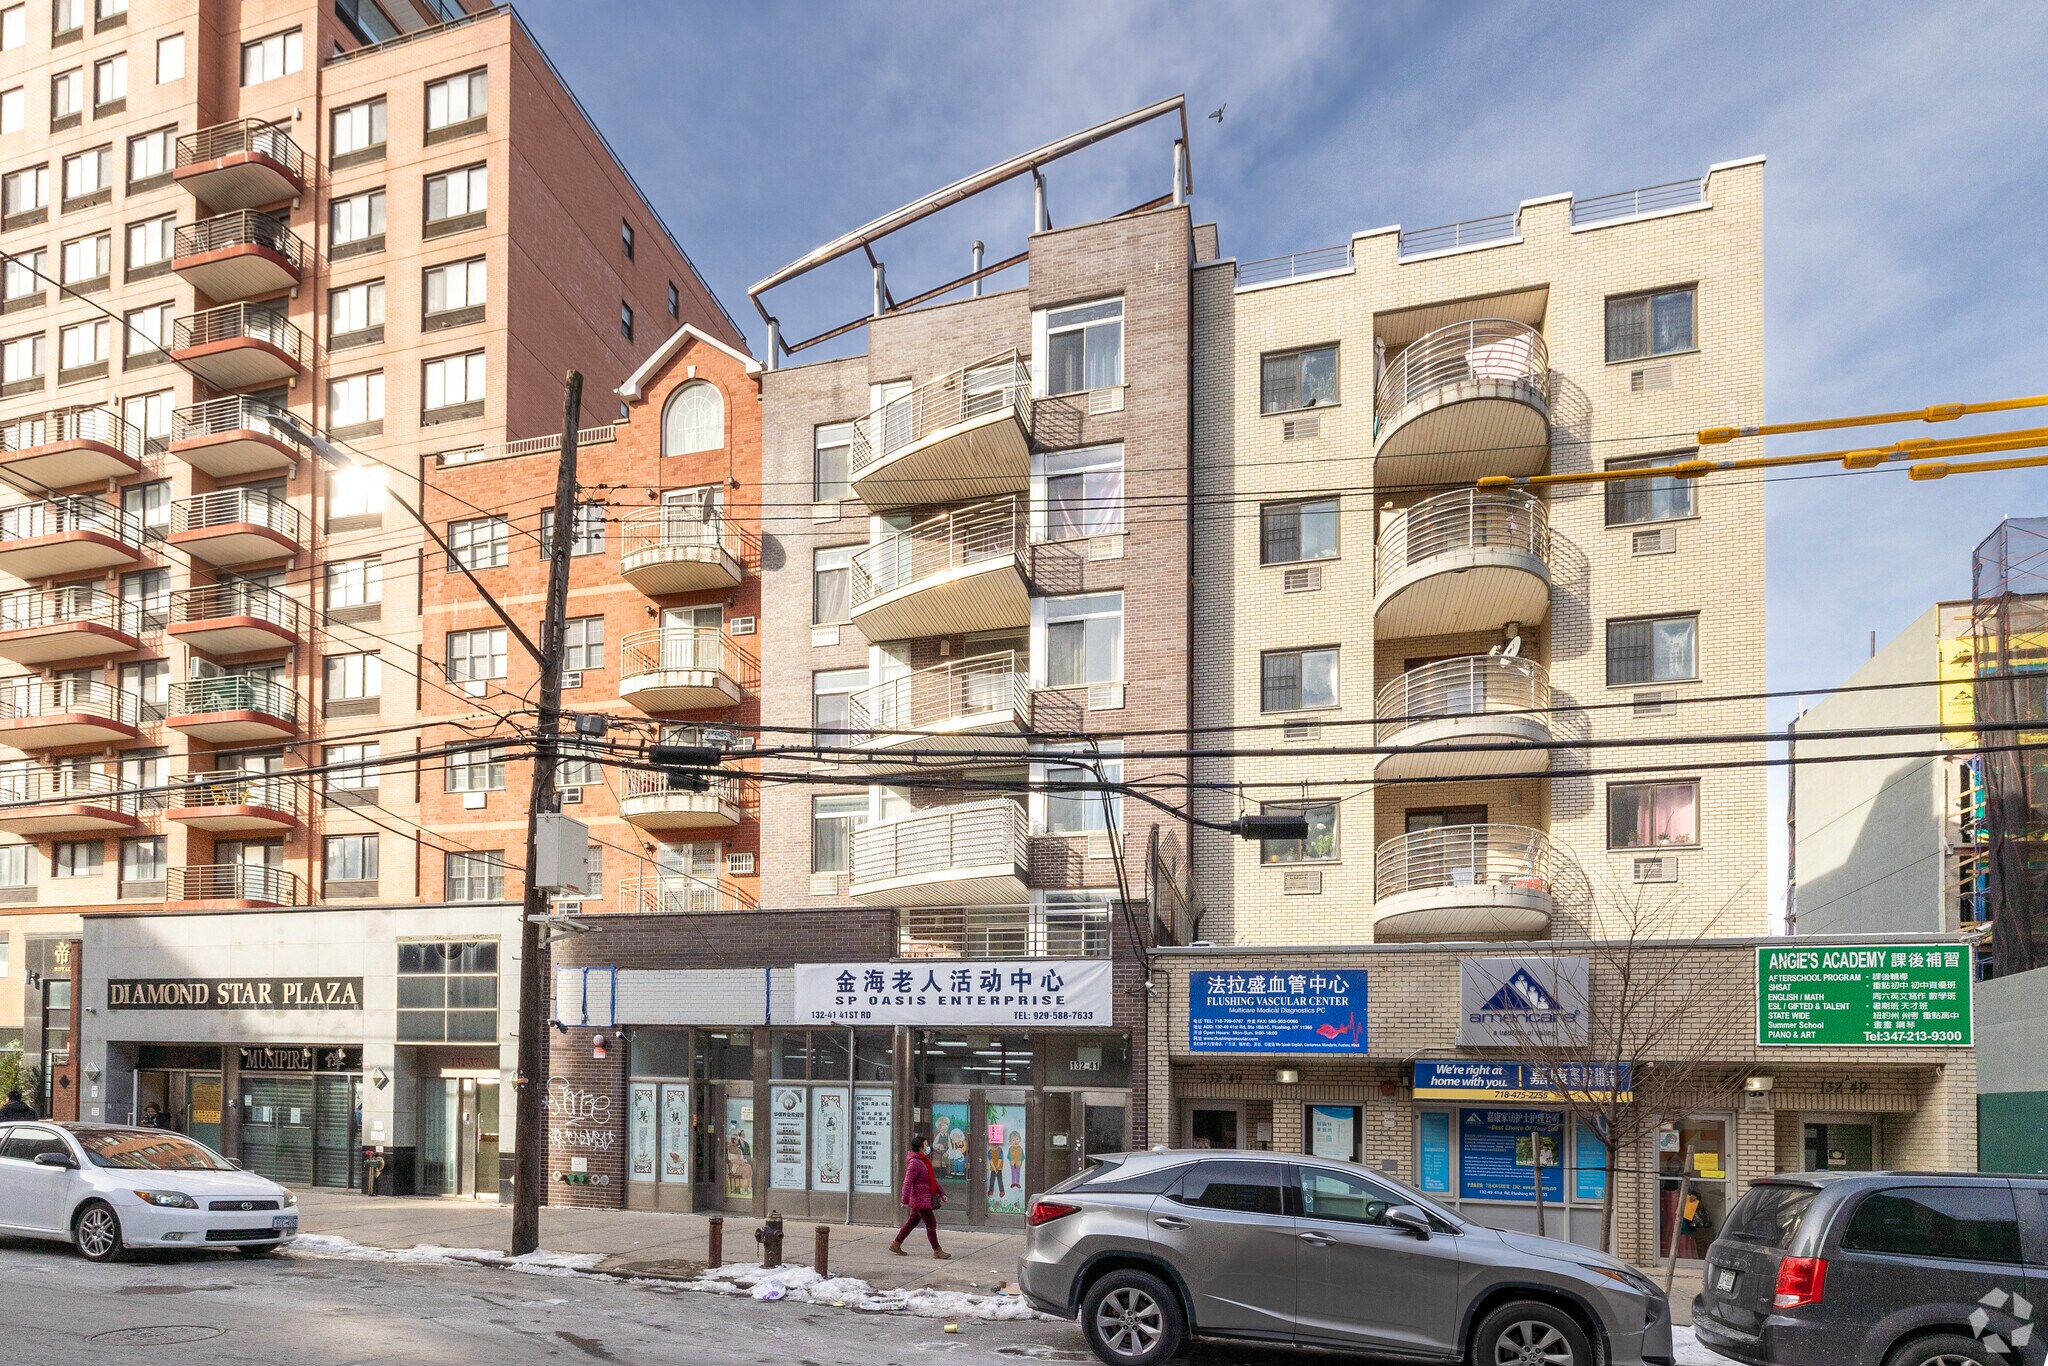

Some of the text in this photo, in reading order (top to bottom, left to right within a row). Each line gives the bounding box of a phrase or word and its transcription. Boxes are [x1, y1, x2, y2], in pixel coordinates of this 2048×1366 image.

[54, 942, 70, 964] 帝
[1769, 951, 1960, 970] ANGIE'S ACADEMY 課後補習
[836, 968, 1064, 994] 金海老人活动中心
[1768, 974, 1821, 982] AFTERSCHOOL
[1207, 974, 1350, 995] 法拉盛血管中心
[110, 982, 358, 1005] DIAMOND STAR PLAZA
[1929, 992, 1956, 1000] 數學班
[835, 995, 1066, 1005] SP OASIS ENTERPRISE
[1206, 996, 1349, 1006] FLUSHING VASCULAR CENTER
[1901, 1002, 1928, 1010] 天才班
[811, 1011, 871, 1020] 132-41 41ST RD
[1014, 1012, 1094, 1020] TEL: 929-588-7633
[1470, 1012, 1576, 1023] americare
[1863, 1031, 1962, 1041] Tel:347-213-9300
[246, 1048, 310, 1070] MUSIPIRE
[1070, 1061, 1099, 1070] 132-41
[1436, 1065, 1502, 1076] We're right at
[1430, 1076, 1508, 1088] home with you.
